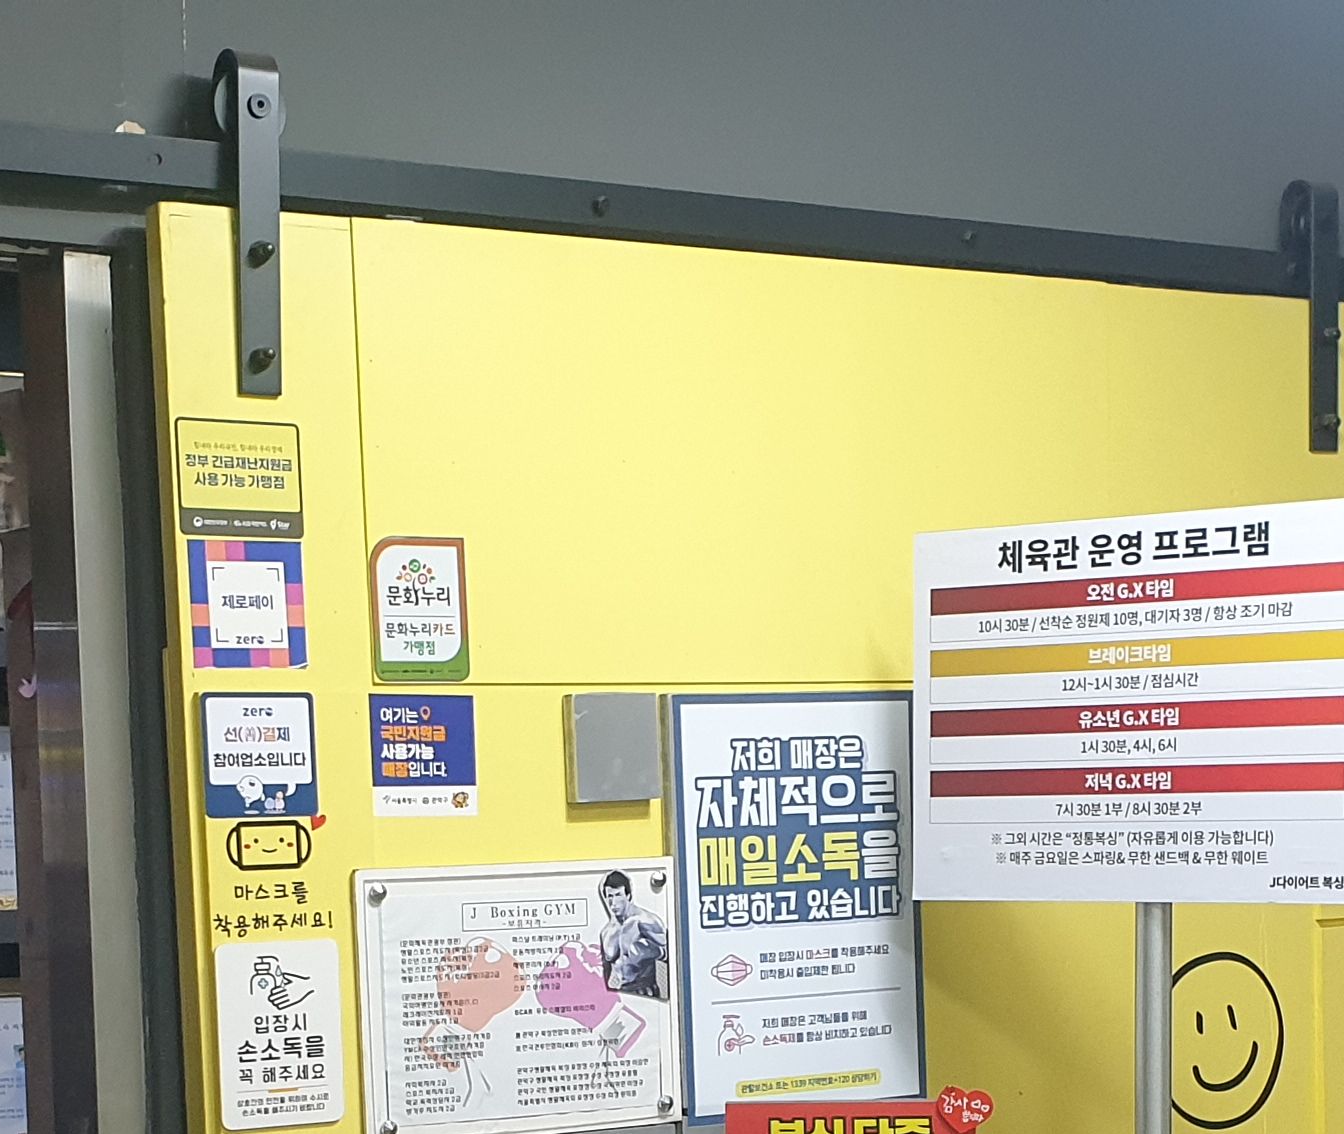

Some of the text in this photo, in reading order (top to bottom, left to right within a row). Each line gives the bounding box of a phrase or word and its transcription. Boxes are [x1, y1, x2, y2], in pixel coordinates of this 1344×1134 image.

[185, 454, 292, 472] 정부 긴급재난지원금
[194, 472, 284, 489] 사용 가능 가맹점
[998, 521, 1270, 573] 체육관 운영 프로그램
[387, 580, 450, 606] 문화누리
[1087, 579, 1174, 601] 오전 G.X 타임
[222, 595, 274, 610] 제로페이
[979, 602, 1292, 633] 10시 30분 선착순 정원제 10명, 대기자 3명 항상 조기 마감
[236, 635, 264, 644] zero
[385, 623, 455, 638] 문화누리카드
[404, 641, 435, 655] 가맹점
[1088, 643, 1171, 664] 브레이크타임
[1062, 672, 1198, 691] 12시~1시 30분 점심시간
[243, 707, 273, 716] zero
[380, 707, 418, 723] 여기는
[1079, 707, 1179, 729] 유소년 G.X 타임
[380, 725, 446, 742] 국민지원금
[381, 744, 434, 760] 사용가능
[731, 737, 862, 772] 저희 매장은
[1081, 737, 1177, 755] 1시 30분, 4시, 6시
[213, 753, 306, 768] 참여업소입니다
[1085, 771, 1171, 791] 저녁 G.X 타임
[696, 772, 898, 828] 자체적으로
[1056, 801, 1202, 816] 7시 30분 1부 8시 30분 2부
[1005, 832, 1027, 845] 그외
[1030, 832, 1063, 845] 시간은
[1127, 831, 1178, 846] (자유롭게
[1181, 831, 1205, 845] 이용
[1208, 830, 1274, 846] 가능합니다)
[1010, 852, 1032, 865] 매주
[1034, 852, 1079, 865] 금요일은
[1127, 851, 1151, 865] 무한
[1154, 851, 1190, 865] 샌드백
[1192, 853, 1201, 864] &
[1204, 851, 1228, 865] 무한
[1231, 851, 1268, 865] 웨이트
[1269, 876, 1344, 889] J다이어트 복싱
[234, 881, 308, 904] 마스크를
[470, 903, 575, 919] J Boxing GYM
[701, 885, 900, 929] 진행하고 있습니다
[213, 911, 333, 937] 착용해주세요!
[760, 952, 776, 963] 매장
[779, 951, 804, 962] 입장시
[806, 948, 838, 960] 마스크를
[254, 1013, 307, 1034] 입장시
[762, 1017, 778, 1028] 저희
[781, 1016, 806, 1027] 매장은
[852, 1010, 867, 1021] 위해
[763, 1032, 804, 1046] 손소독제를
[859, 1025, 892, 1037] 있습니다
[238, 1036, 325, 1063] 손소독을
[239, 1064, 325, 1084] 꼭 해주세요
